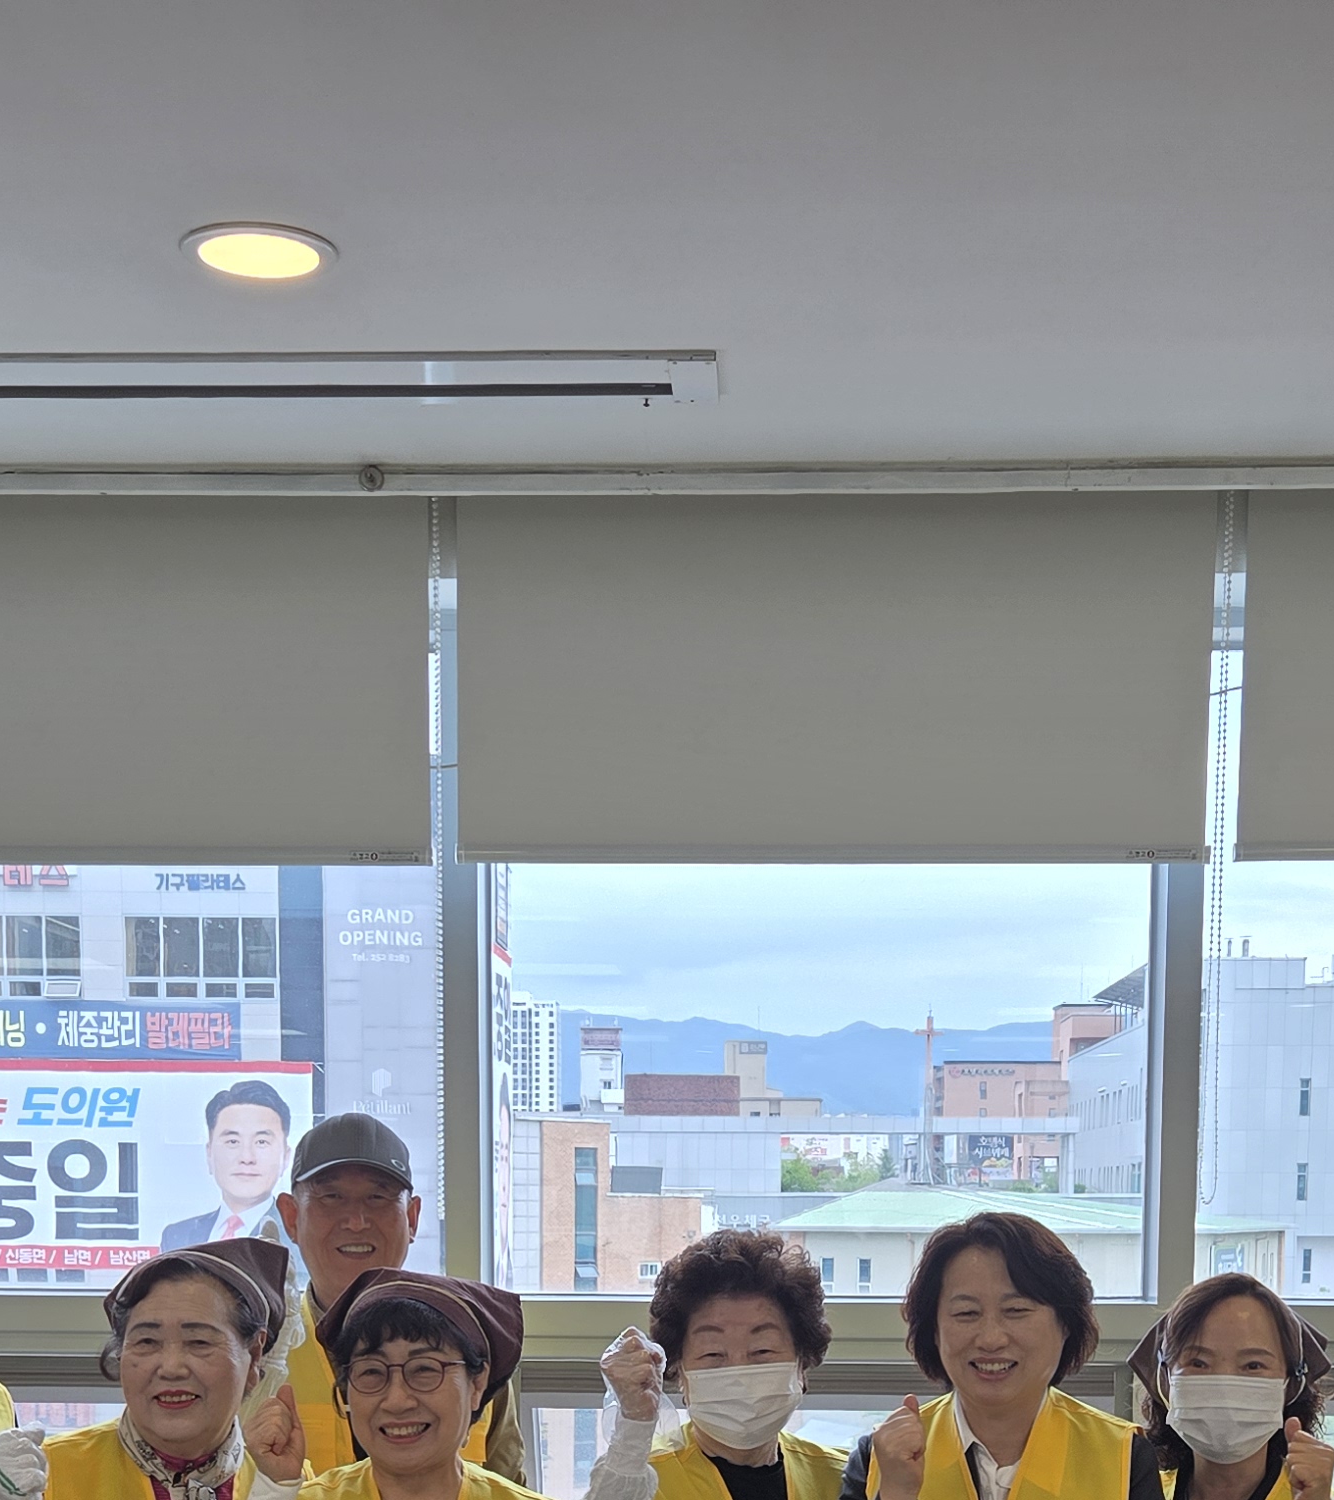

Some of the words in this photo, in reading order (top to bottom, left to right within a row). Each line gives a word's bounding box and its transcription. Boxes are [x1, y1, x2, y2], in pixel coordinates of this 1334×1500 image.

[155, 873, 246, 891] 기구필라테스
[347, 907, 414, 924] GRAND
[339, 930, 423, 946] OPENING
[352, 953, 368, 962] Tel.
[57, 1010, 141, 1048] 체중관리
[146, 1012, 233, 1049] 발레필라
[17, 1086, 142, 1128] 도의원
[5, 1248, 46, 1265] 신동면
[64, 1249, 92, 1266] 남면
